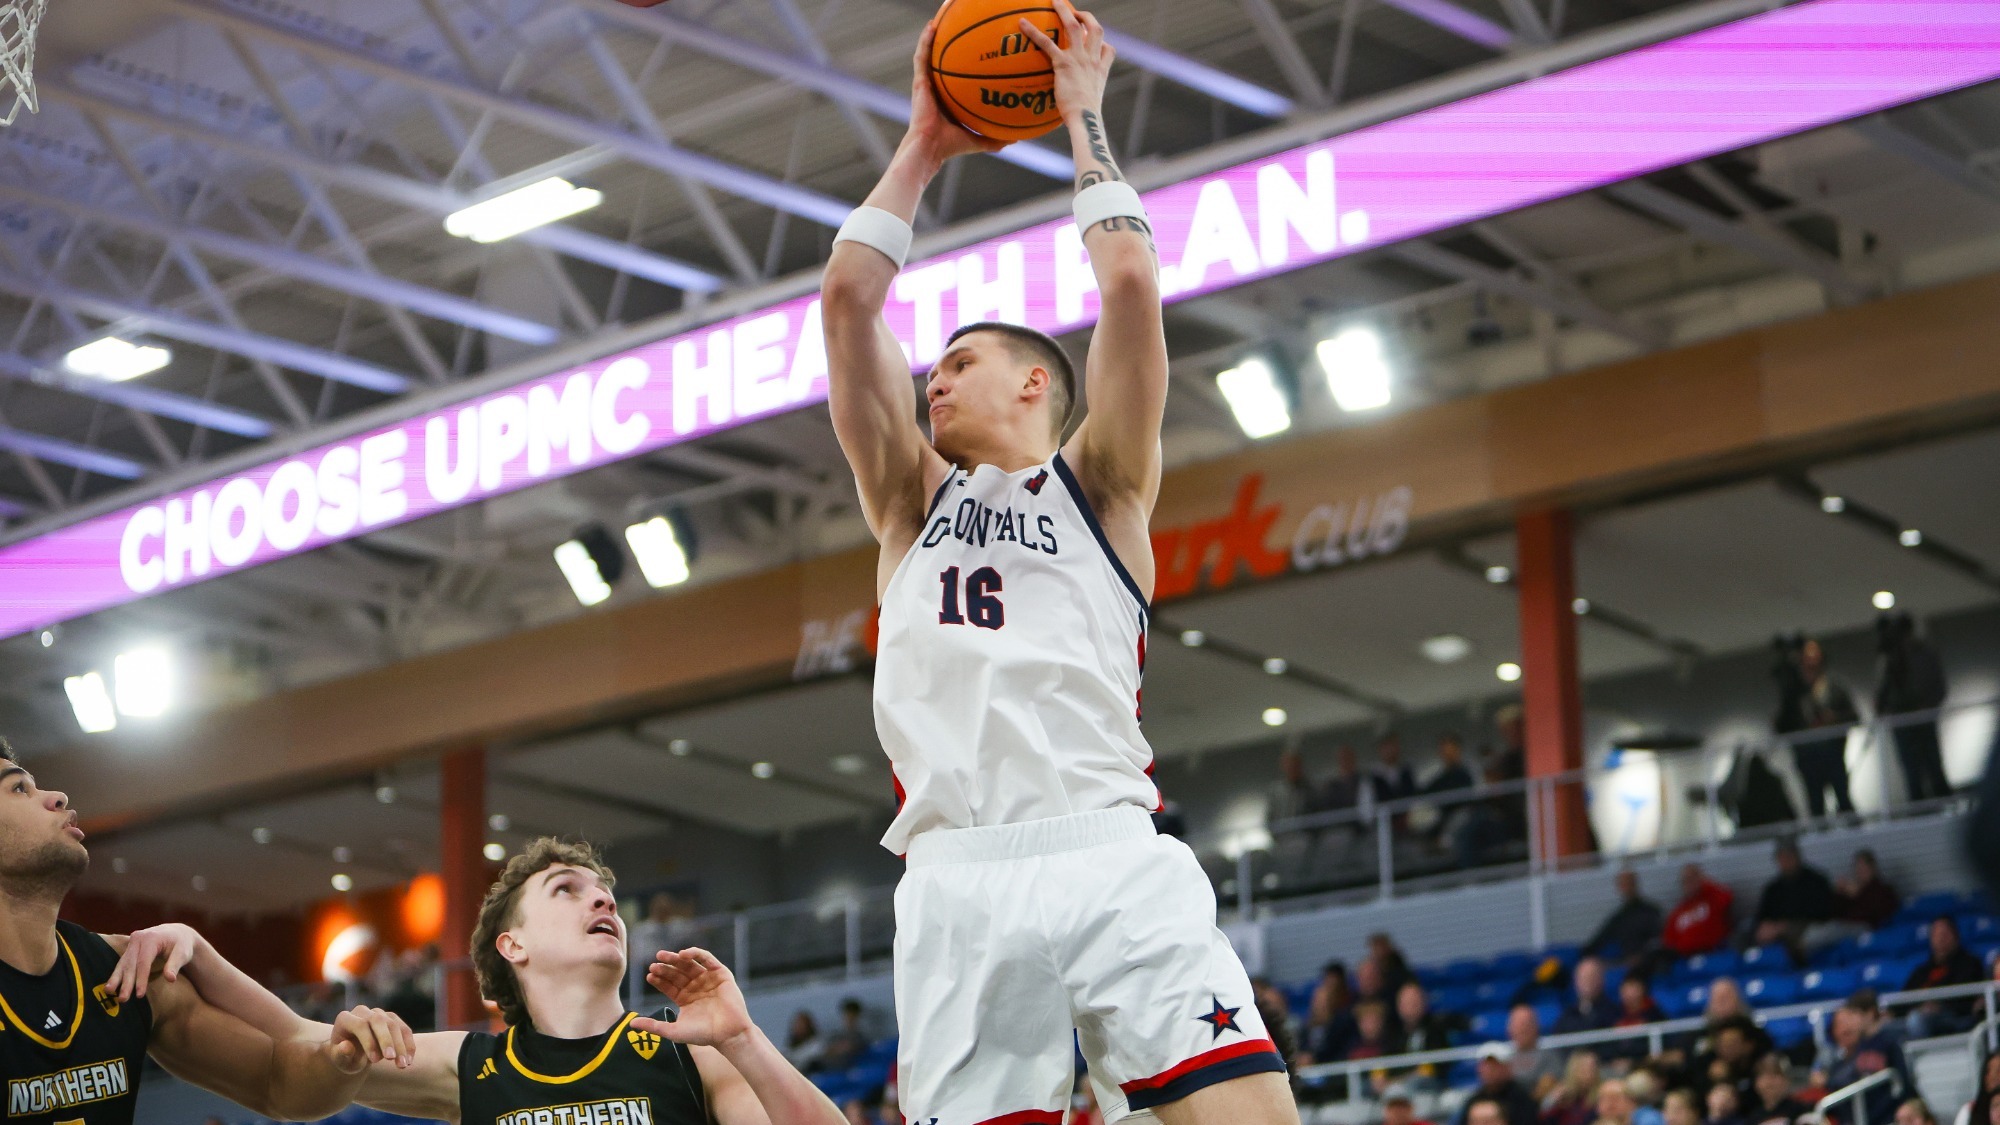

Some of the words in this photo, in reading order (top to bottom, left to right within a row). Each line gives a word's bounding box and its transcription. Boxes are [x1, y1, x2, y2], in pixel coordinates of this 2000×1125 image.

[980, 87, 1057, 115] ilson
[119, 427, 409, 593] CHOOSE
[424, 356, 651, 504] UPMC
[671, 239, 1026, 436] HEATH
[1292, 485, 1412, 572] CLUB
[938, 565, 1005, 631] 16
[9, 1059, 128, 1116] NORTHERN
